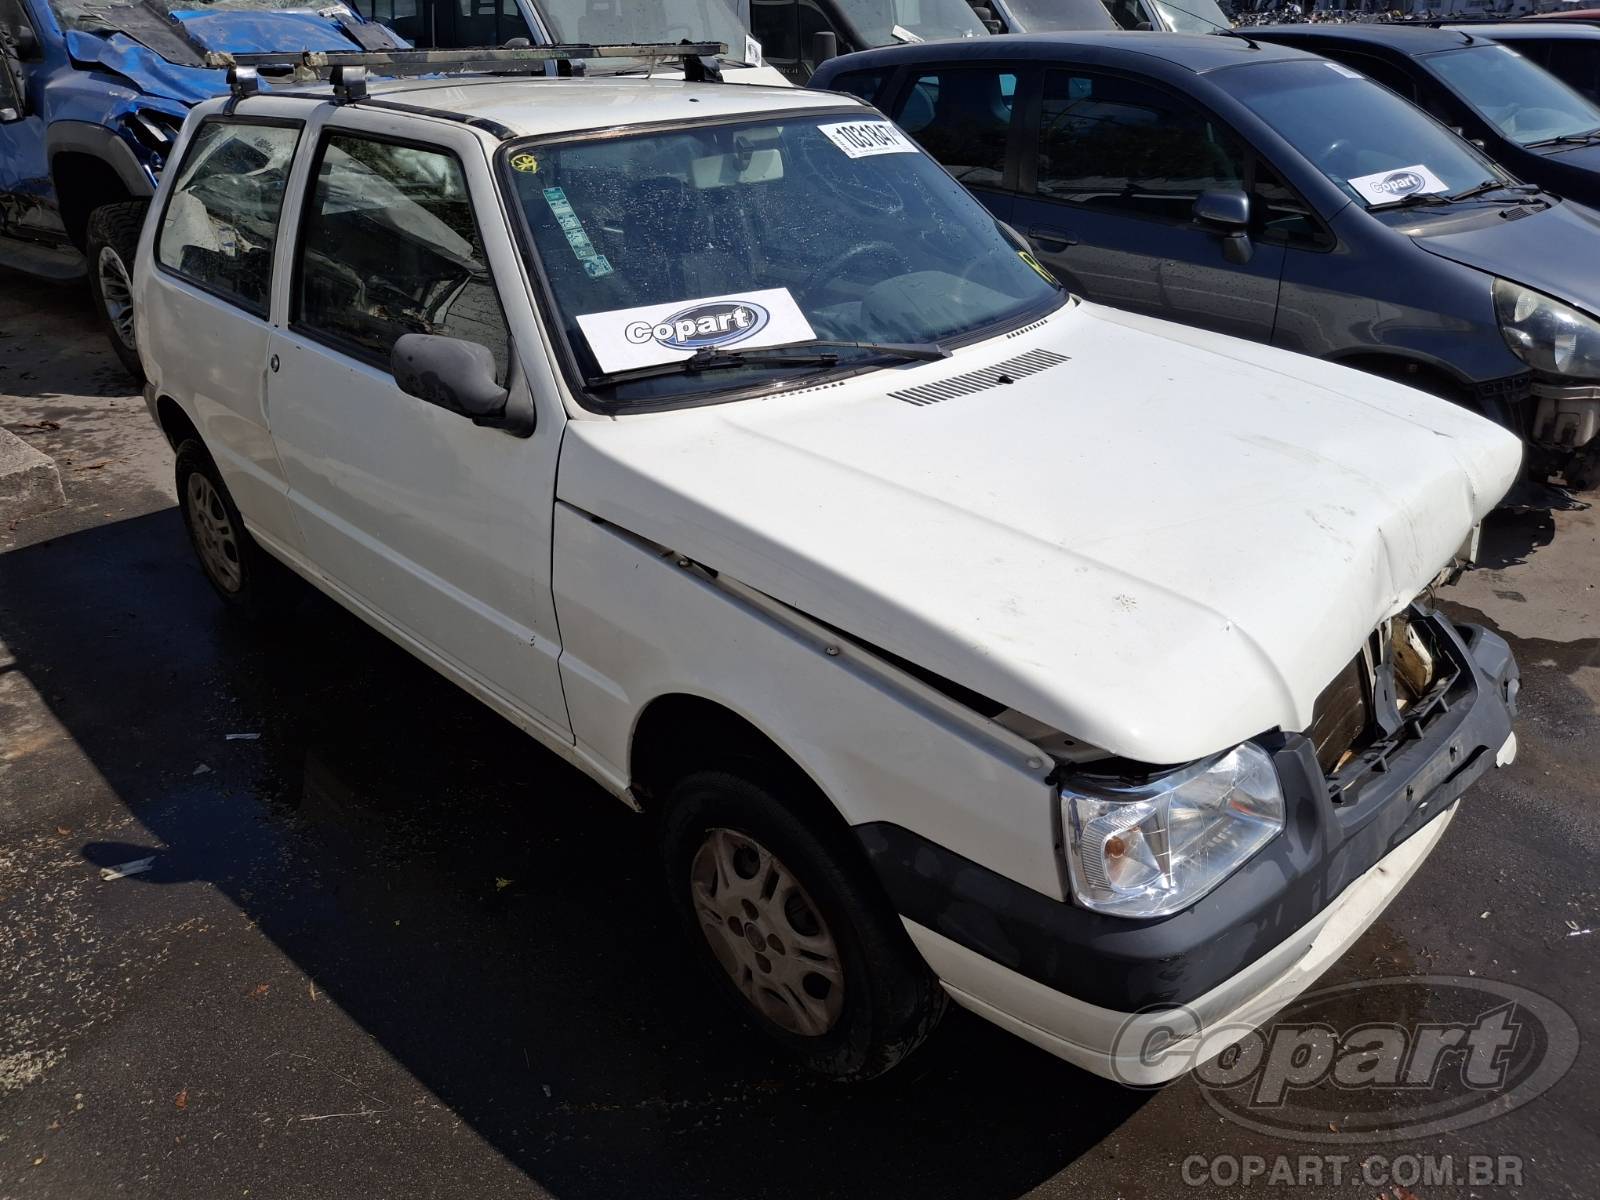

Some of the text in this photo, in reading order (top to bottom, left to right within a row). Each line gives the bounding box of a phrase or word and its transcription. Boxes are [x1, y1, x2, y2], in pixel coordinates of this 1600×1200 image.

[836, 124, 901, 149] 1031847
[1370, 174, 1418, 193] Copart
[624, 304, 751, 345] Copart
